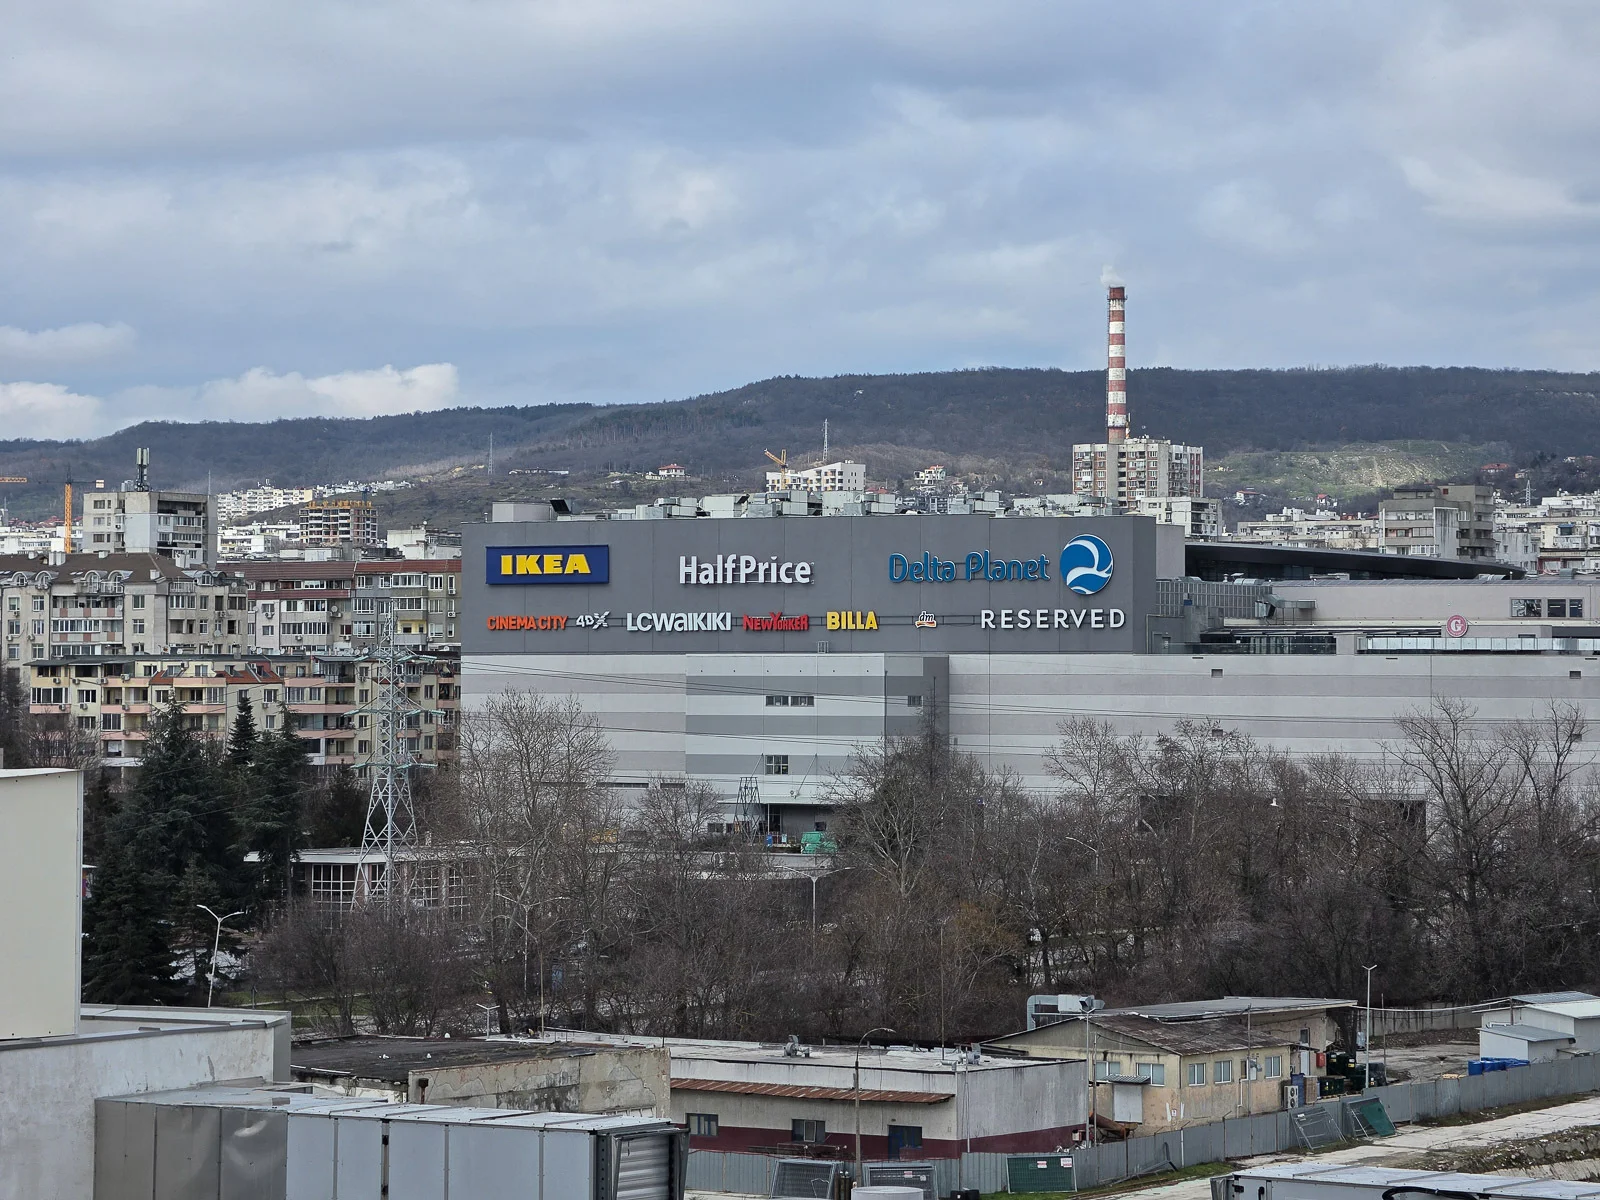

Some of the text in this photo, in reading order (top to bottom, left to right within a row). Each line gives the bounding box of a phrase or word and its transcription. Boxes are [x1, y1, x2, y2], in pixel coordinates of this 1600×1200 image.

[500, 554, 592, 576] IKEA
[679, 554, 812, 585] HalfPrice
[889, 549, 1050, 583] Delta Planet
[486, 615, 568, 631] CINEMA CITY
[575, 610, 610, 630] 4DX
[826, 611, 878, 631] BILLA
[981, 608, 1126, 629] RESERVED
